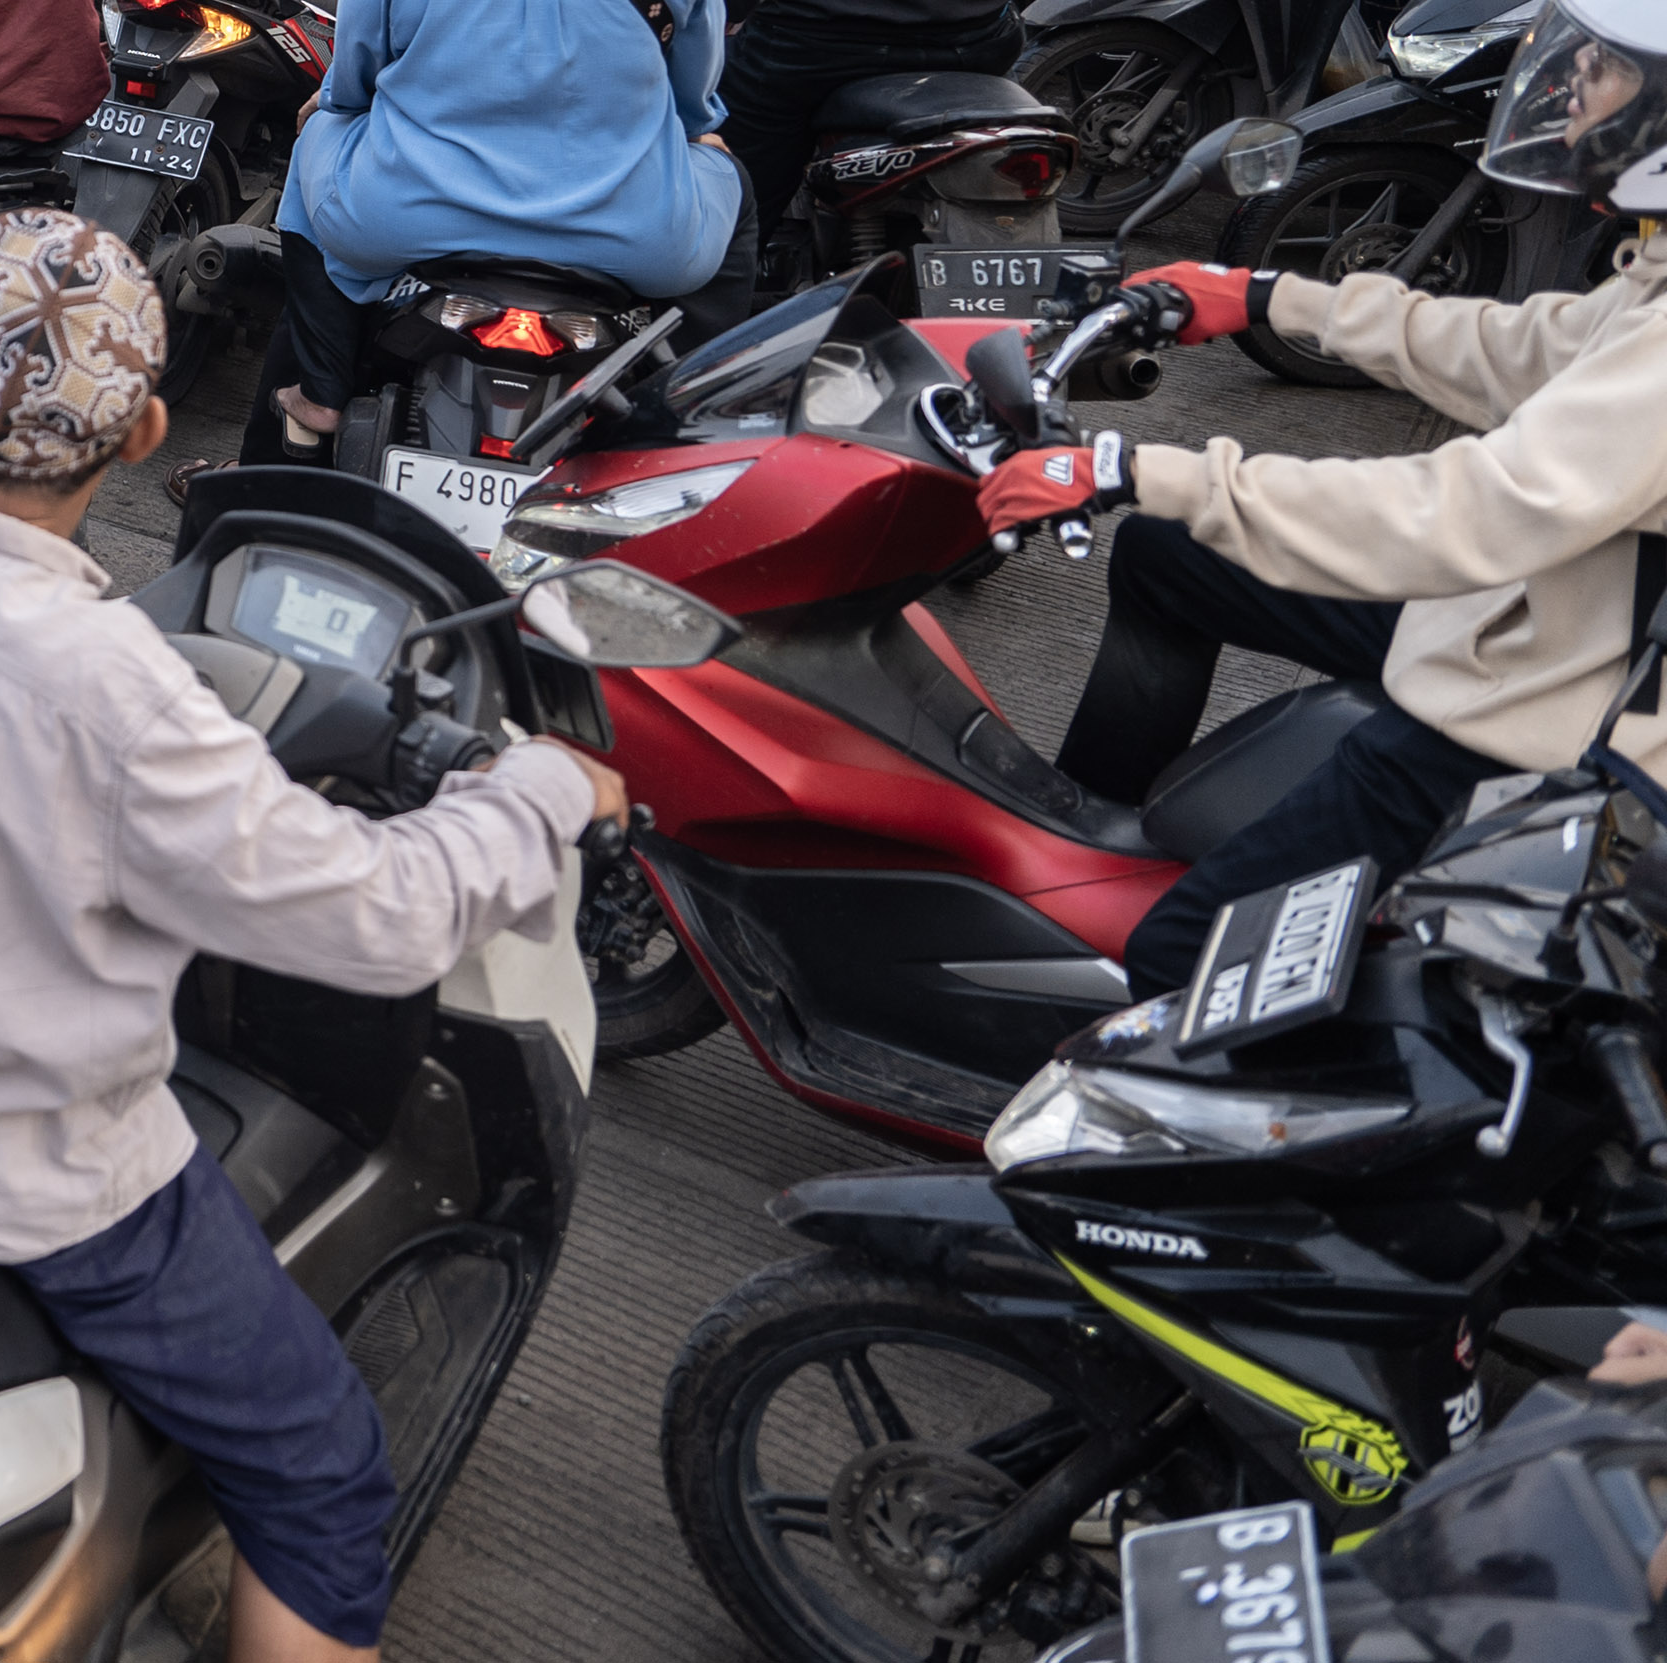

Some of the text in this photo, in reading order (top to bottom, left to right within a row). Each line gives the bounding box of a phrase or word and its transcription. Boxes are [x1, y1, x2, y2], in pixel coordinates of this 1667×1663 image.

[127, 49, 161, 60] HONDA
[265, 25, 312, 64] 125
[157, 118, 207, 149] FXC
[834, 150, 916, 180] REVO
[930, 257, 1043, 287] B 6767
[395, 461, 518, 507] F 4980
[1074, 1218, 1210, 1262] HONDA
[1218, 1515, 1309, 1663] B 367
